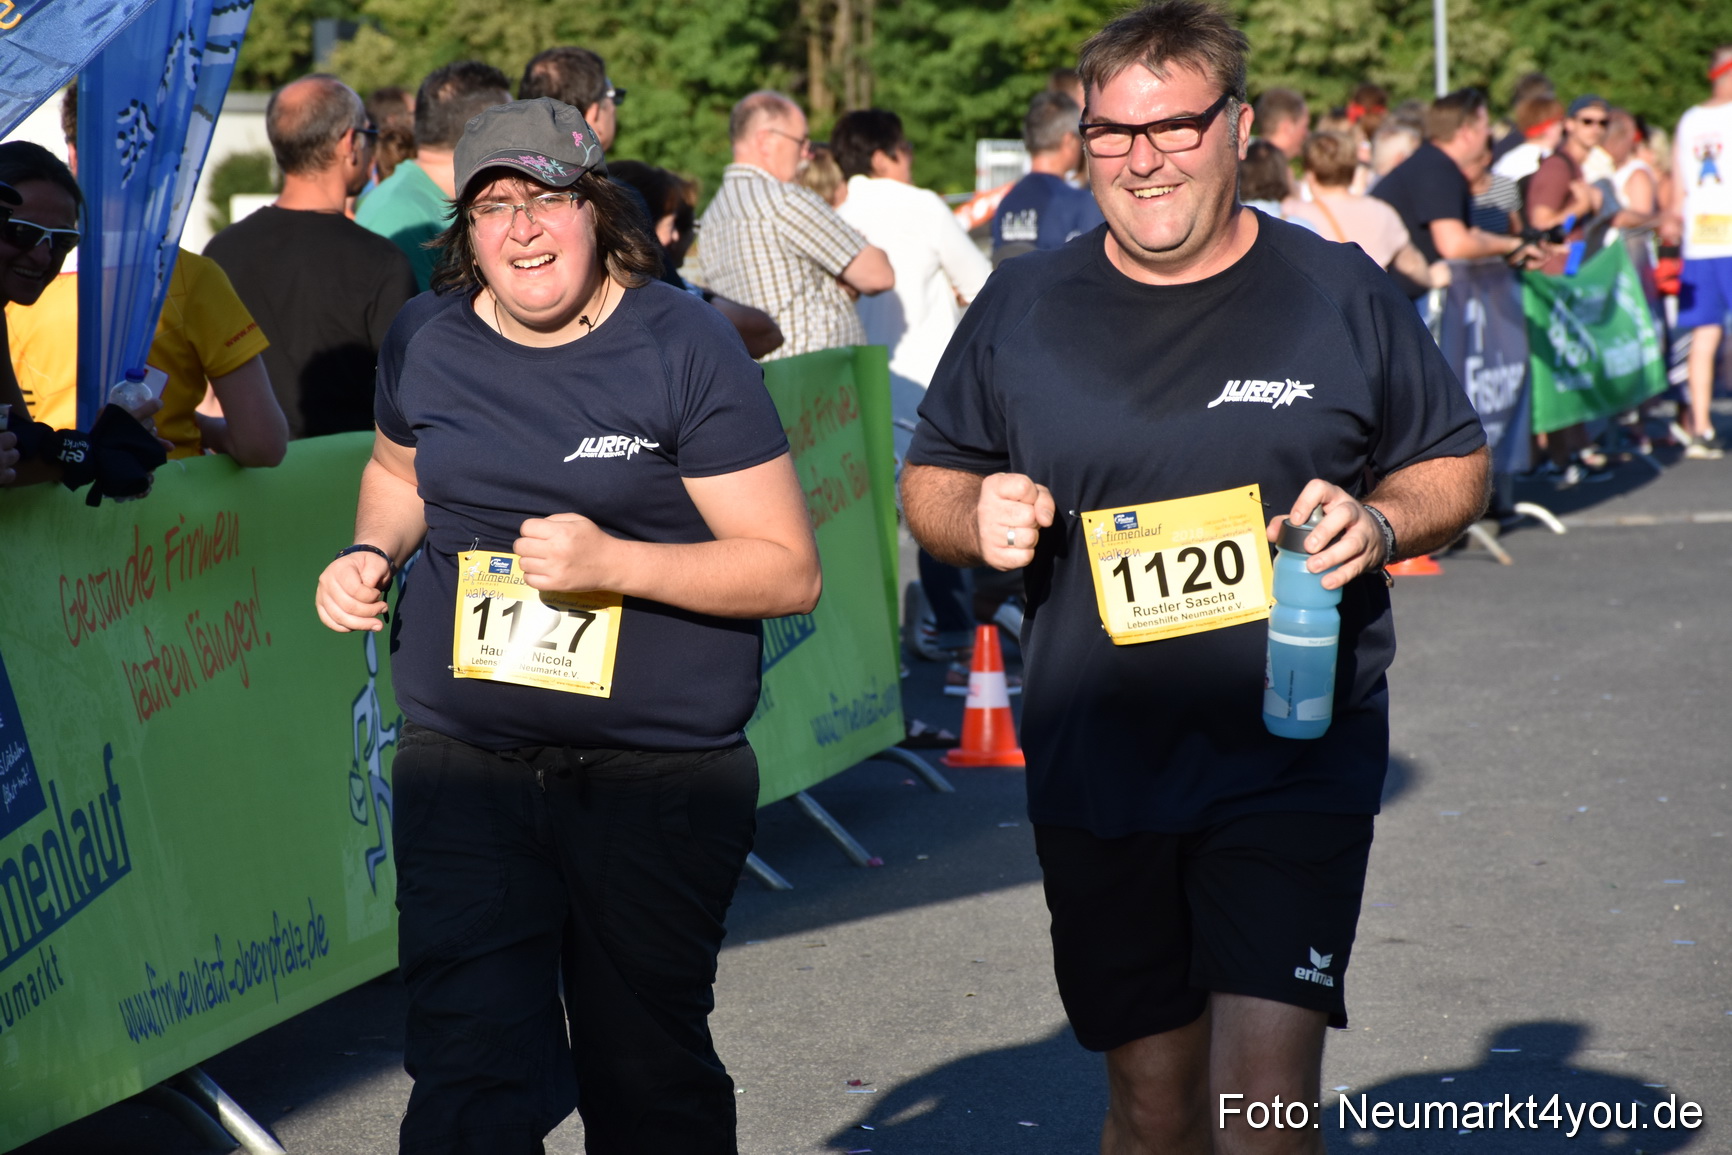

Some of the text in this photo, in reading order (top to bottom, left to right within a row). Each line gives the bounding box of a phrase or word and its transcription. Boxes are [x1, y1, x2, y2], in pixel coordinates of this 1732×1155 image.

[1207, 379, 1285, 409] JURA
[563, 435, 632, 462] JURA
[1106, 523, 1163, 542] firmenlauf
[59, 510, 240, 648] Gesunde Firmen
[477, 571, 527, 586] firmenlau
[1112, 540, 1245, 603] 1120
[1127, 613, 1179, 630] Lebenshilfe
[1181, 605, 1226, 620] Neumarkt
[1228, 602, 1245, 613] e.V.
[1133, 592, 1236, 617] Rustler Sascha
[472, 597, 597, 654] 1127
[122, 566, 272, 725] laufen länger!
[480, 644, 573, 668] Hau Nicola
[471, 657, 580, 680] Lebens Neumarkt e.V.
[118, 896, 330, 1045] www.firmenlauf-oberpfalz.de
[1294, 966, 1335, 988] erima
[0, 944, 64, 1035] umarkt
